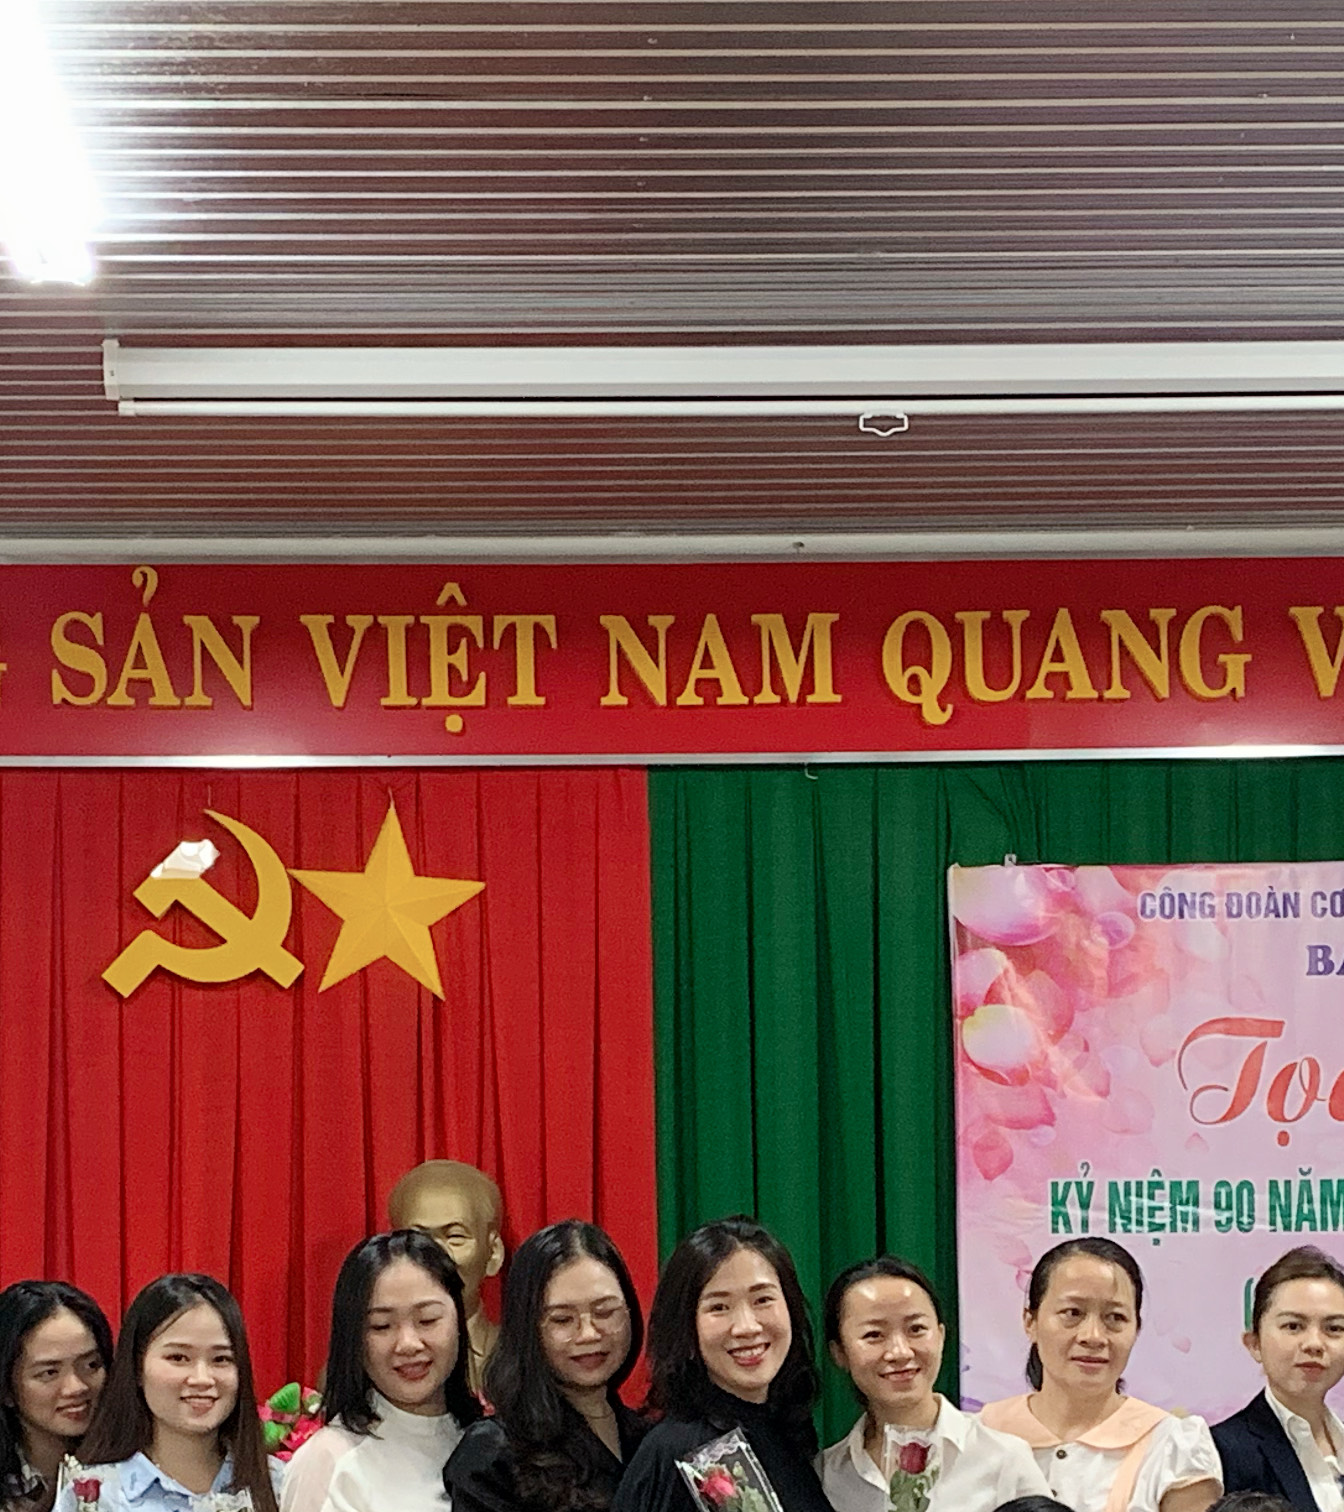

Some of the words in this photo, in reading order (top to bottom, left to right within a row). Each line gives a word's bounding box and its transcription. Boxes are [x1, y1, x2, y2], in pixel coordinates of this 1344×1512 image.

[51, 566, 259, 708] SẢN
[299, 582, 558, 734] VIỆT
[598, 611, 842, 708] NAM
[881, 604, 1253, 725] QUANG
[1139, 886, 1217, 920] CÔNG
[1224, 886, 1301, 919] ĐOÀN
[1049, 1161, 1096, 1234] KỶ
[1106, 1168, 1201, 1246] NIỆM
[1212, 1179, 1256, 1233] 90
